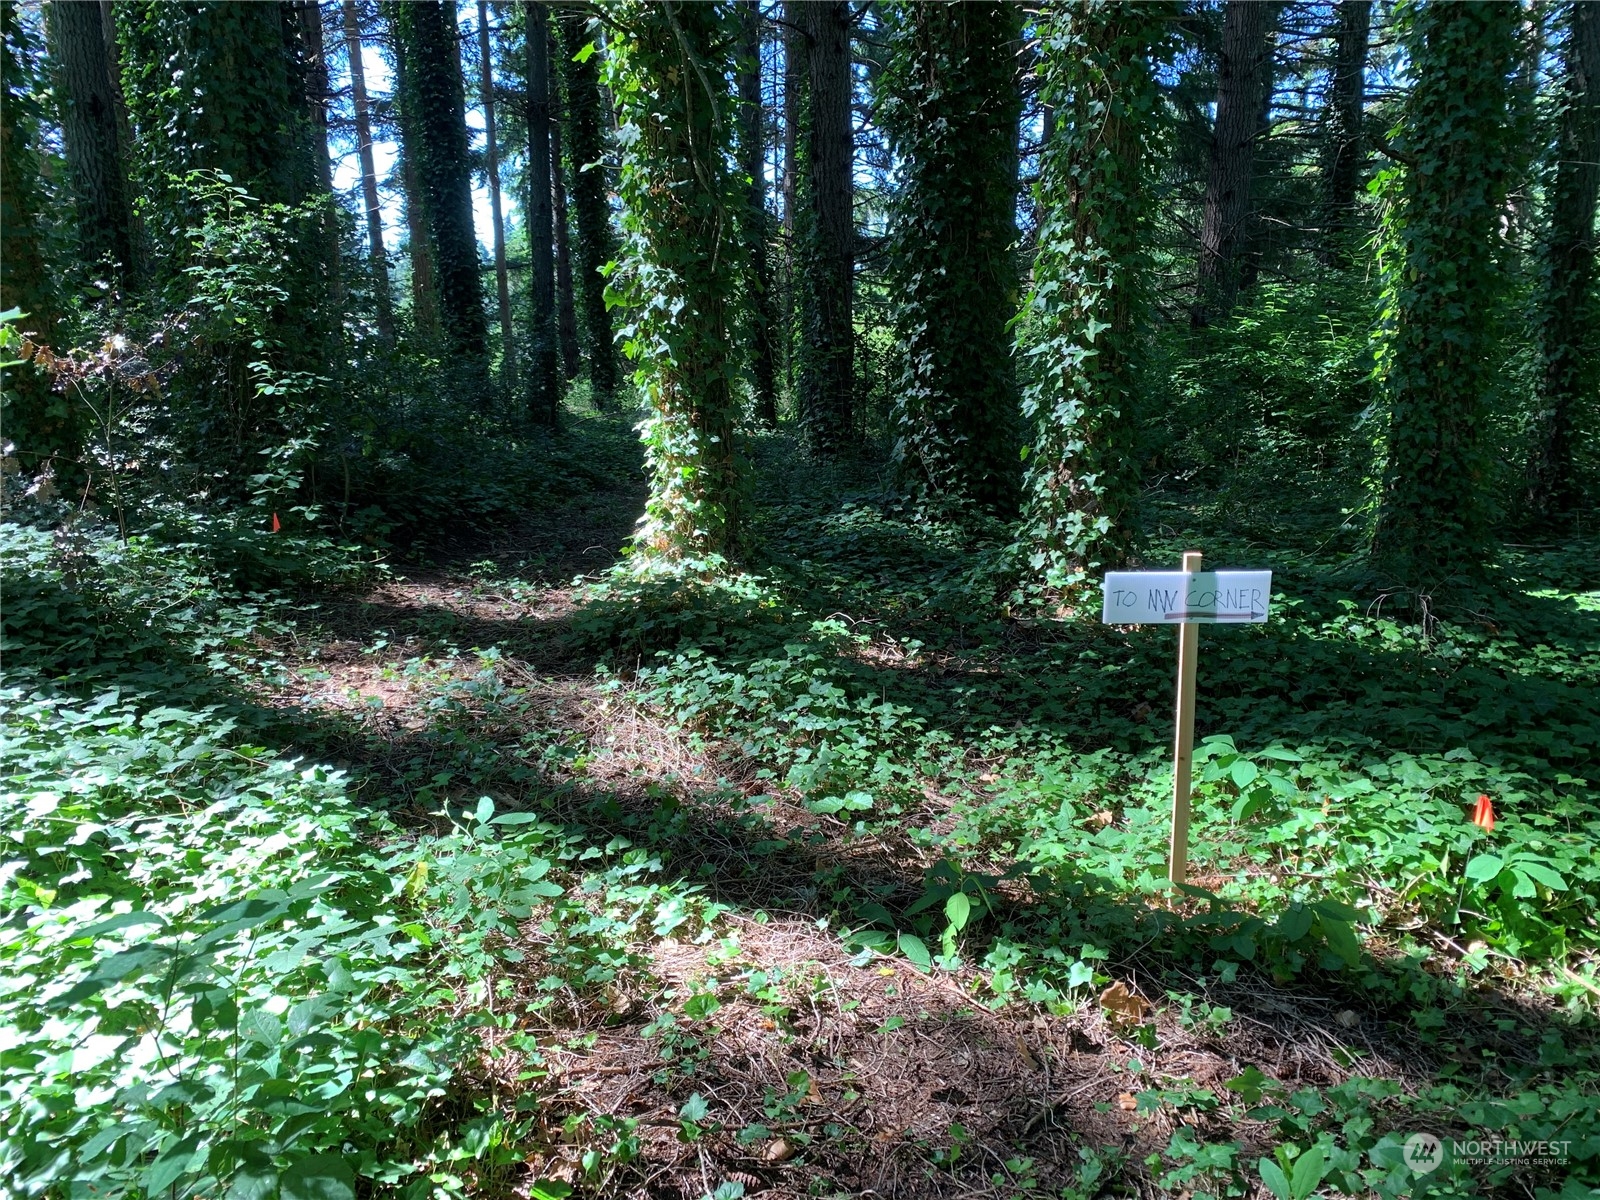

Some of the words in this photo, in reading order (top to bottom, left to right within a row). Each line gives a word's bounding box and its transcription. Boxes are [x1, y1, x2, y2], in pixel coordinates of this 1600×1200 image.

[1113, 590, 1137, 607] TO
[1148, 589, 1178, 613] NW
[1184, 589, 1265, 611] CORNER
